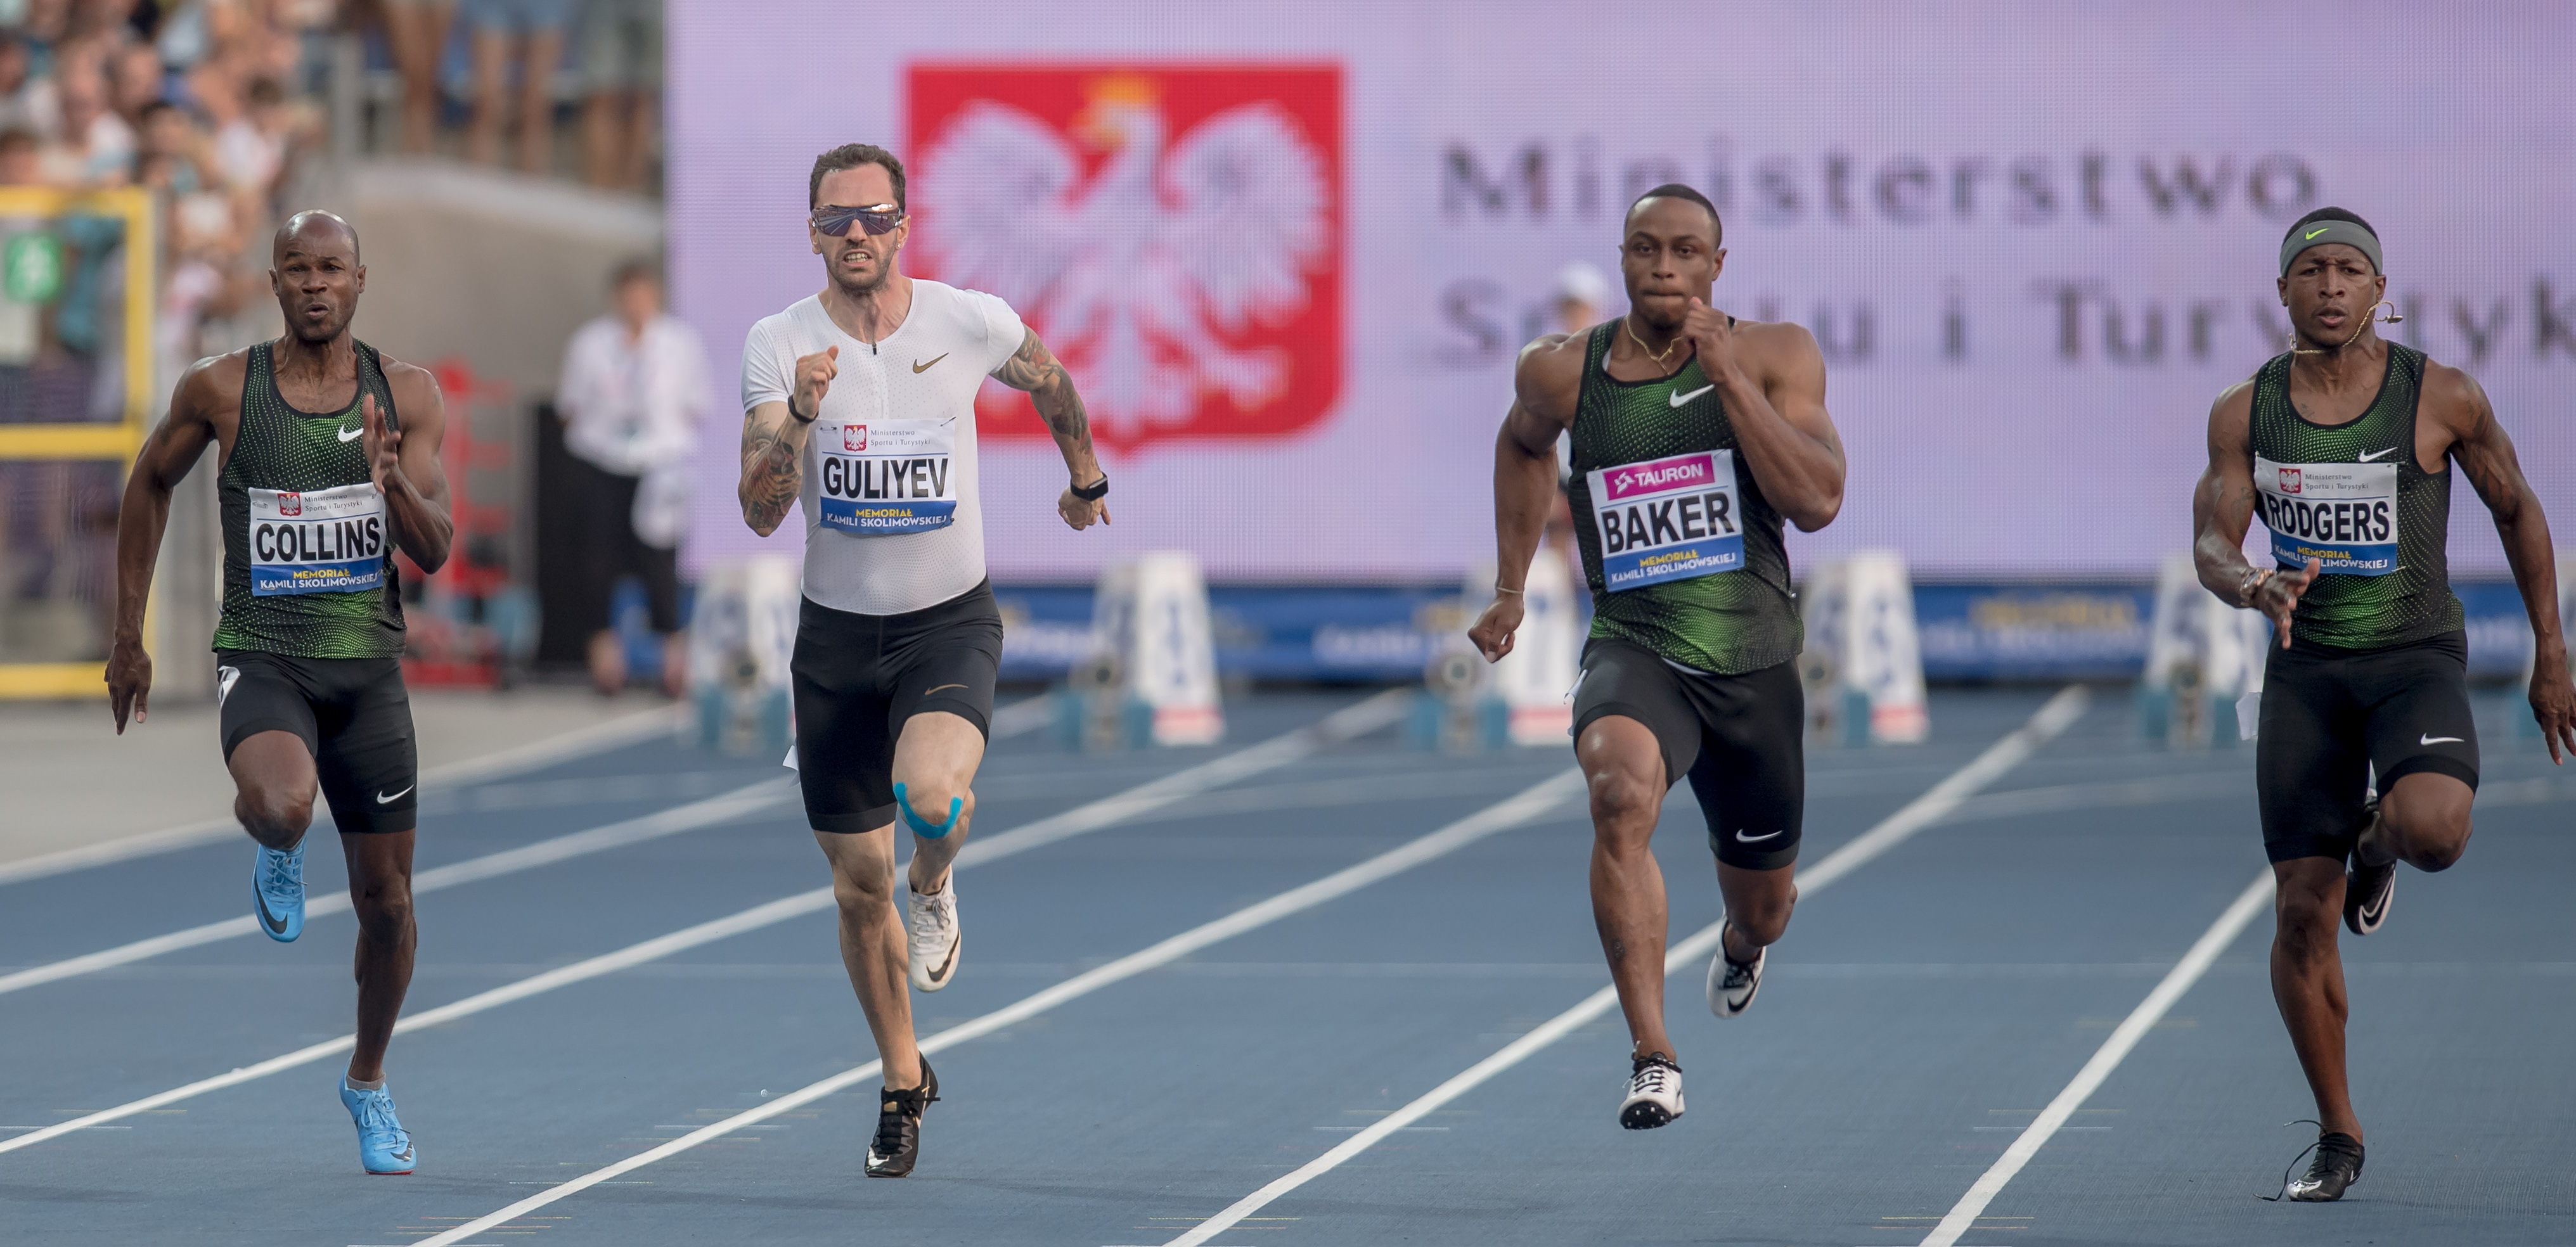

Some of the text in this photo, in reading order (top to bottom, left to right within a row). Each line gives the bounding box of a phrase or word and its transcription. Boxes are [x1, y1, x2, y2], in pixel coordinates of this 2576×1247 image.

[900, 438, 931, 447] Turystyki
[823, 456, 948, 499] GULIYEV
[1633, 463, 1704, 487] TAURON
[2336, 483, 2369, 491] Turystyki
[304, 494, 347, 502] Ministerstwo
[333, 499, 363, 509] Turystyki
[827, 513, 947, 527] KAMILI SKOLIMOWSKIEJ
[856, 508, 913, 518] MEMORIAŁ
[2265, 493, 2390, 542] RODGERS
[1601, 491, 1736, 554] BAKER
[256, 516, 380, 562] COLLINS
[1640, 549, 1699, 568] MEMORIAŁ
[2274, 544, 2388, 569] KAMILI SKLIMOWSKIEJ
[2297, 546, 2352, 560] MEMORIAŁ
[293, 568, 351, 579] MEMORIAŁ
[1611, 552, 1736, 584] KAMILI SKOLIMOWSKIEJ
[260, 573, 378, 590] KAMILI SKOLIMOWSKIEJ
